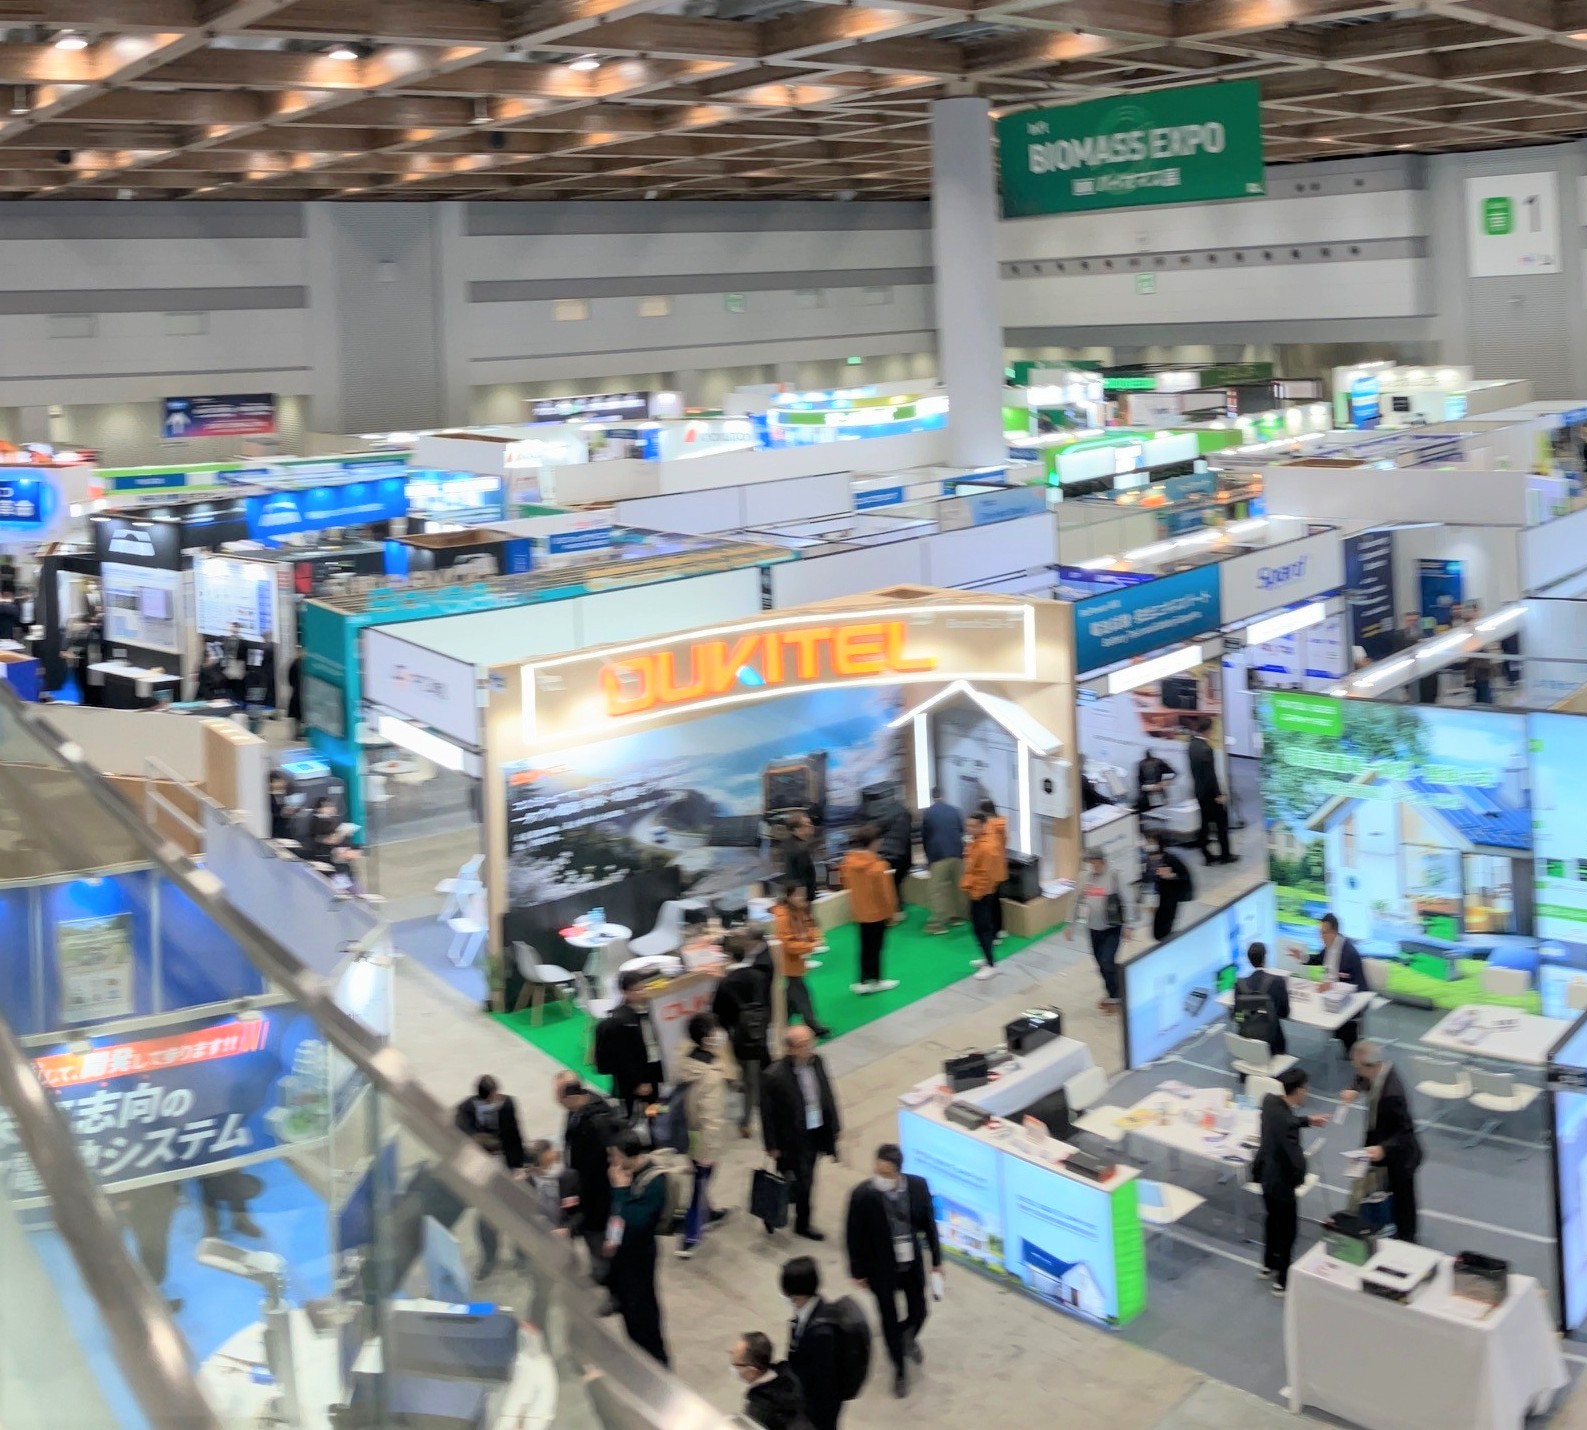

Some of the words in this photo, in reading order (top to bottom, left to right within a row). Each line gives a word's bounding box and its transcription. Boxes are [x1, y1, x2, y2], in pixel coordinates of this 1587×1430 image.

[1028, 130, 1147, 175] BIOMASS
[1150, 121, 1237, 160] EXPO
[1522, 194, 1541, 233] 1
[600, 620, 937, 718] OUKITEL
